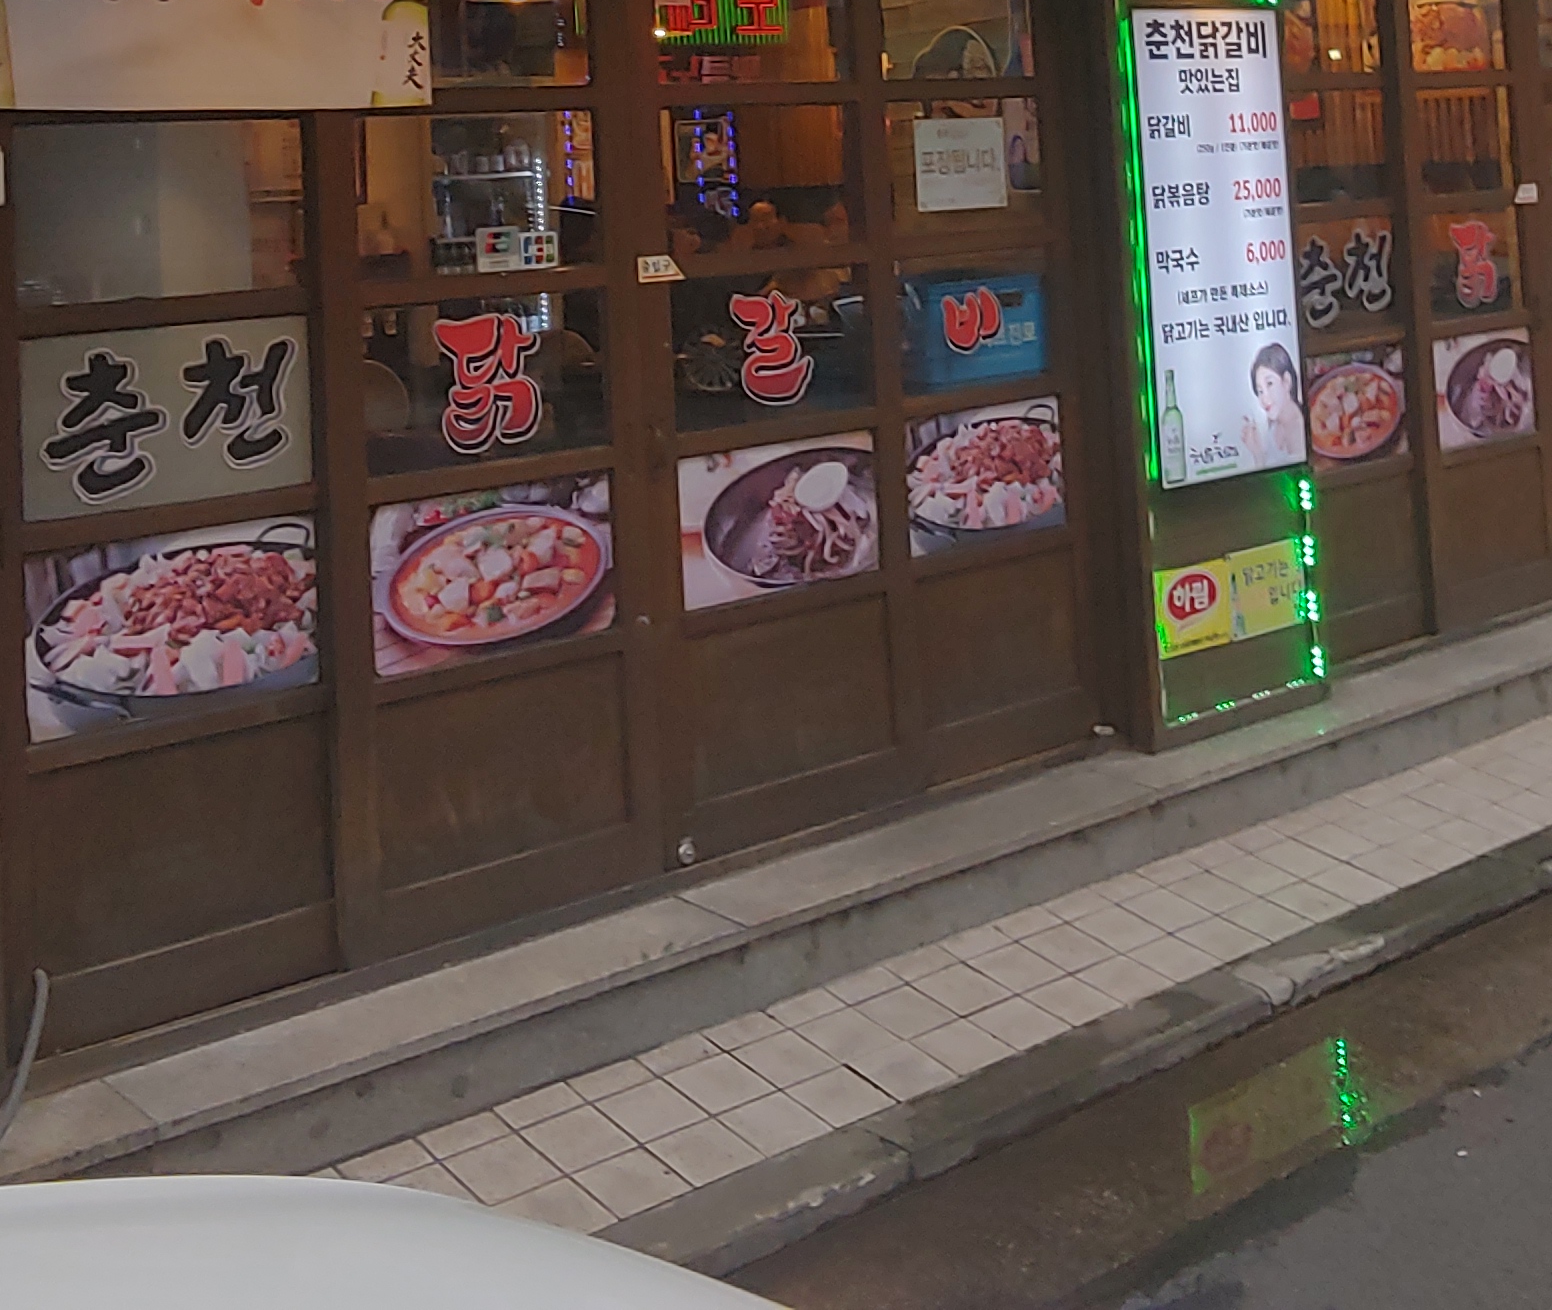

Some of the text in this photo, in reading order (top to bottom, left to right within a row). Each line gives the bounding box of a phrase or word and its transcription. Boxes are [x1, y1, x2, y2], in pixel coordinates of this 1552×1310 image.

[1145, 19, 1267, 60] 춘천닭갈비
[1178, 67, 1241, 94] 맛있는집
[1148, 111, 1277, 139] 닭갈비 11,000
[1152, 177, 1282, 210] 닭볶음탕 25,000
[1156, 240, 1286, 273] 막국수 6,000
[1300, 227, 1391, 328] 춘천
[1162, 308, 1291, 344] 닭고기는 국내산 입니다.
[41, 287, 1004, 504] 춘천 닭 갈 비
[1173, 578, 1209, 612] 하림
